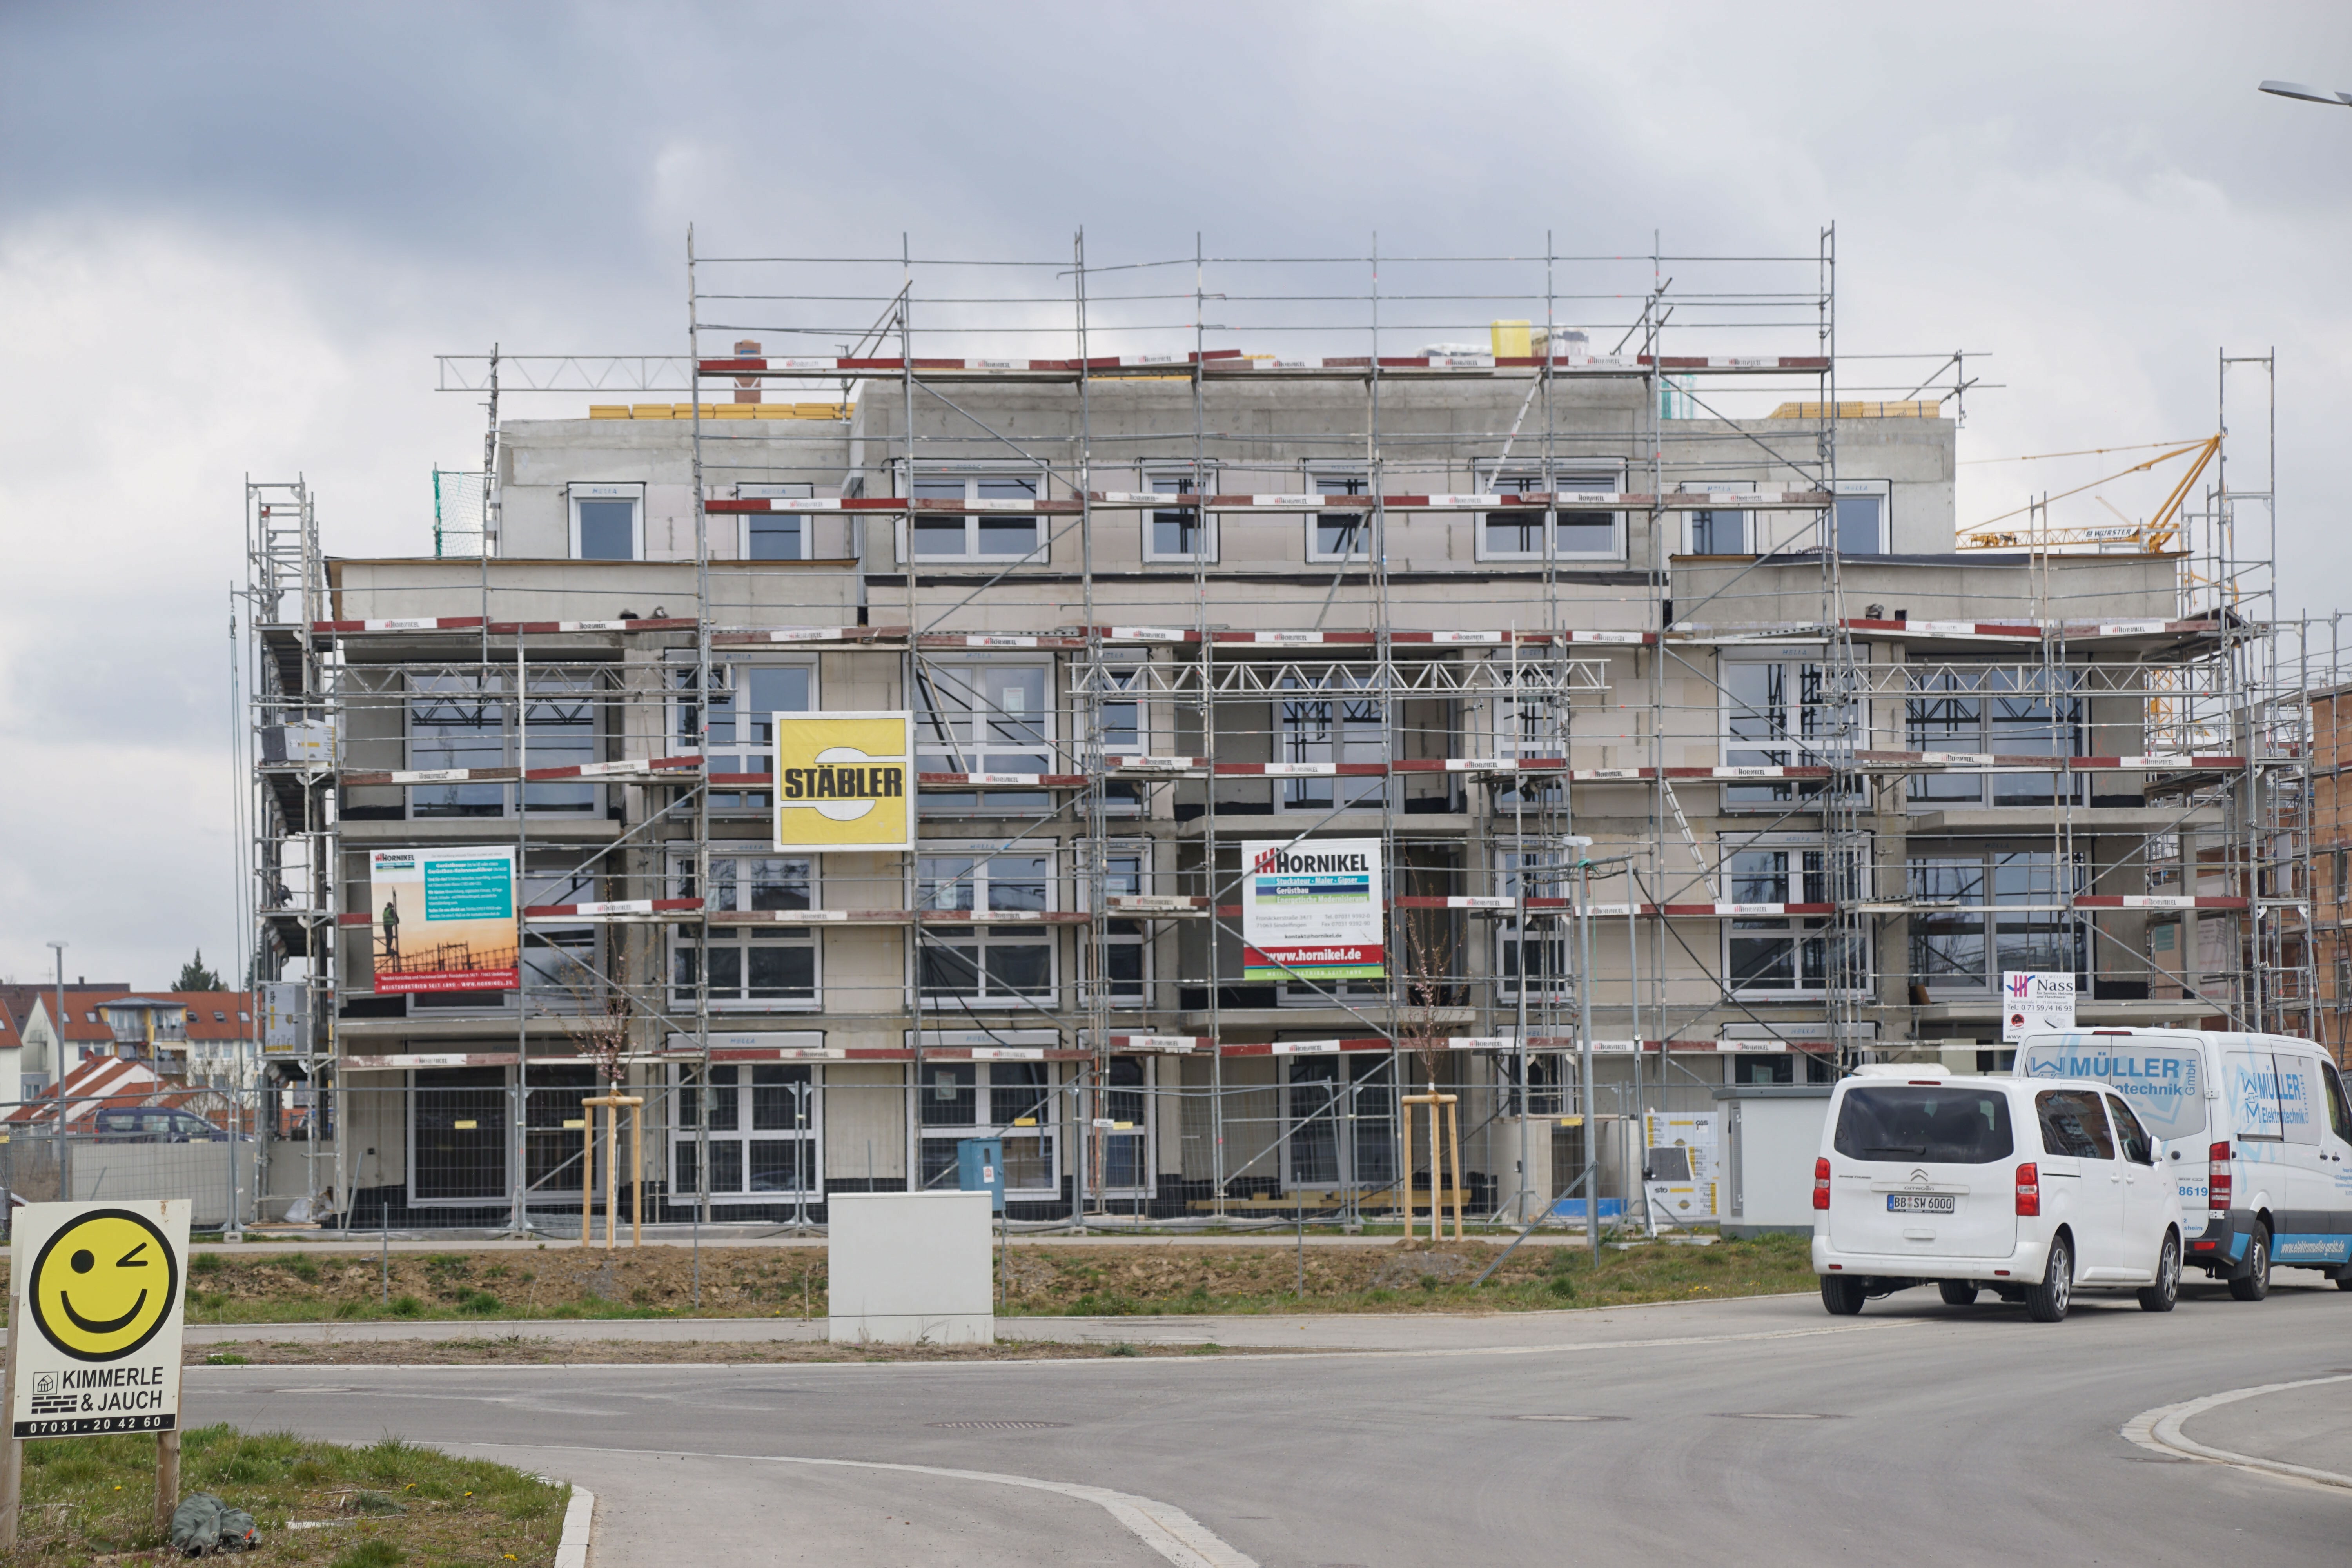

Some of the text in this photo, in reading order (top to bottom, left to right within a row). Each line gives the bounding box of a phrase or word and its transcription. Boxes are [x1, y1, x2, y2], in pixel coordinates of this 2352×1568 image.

[785, 765, 902, 798] STÄBLER
[383, 853, 414, 861] HORNIKEL
[1276, 848, 1369, 873] HORNIKEL
[1338, 877, 1357, 885] Gipser
[1267, 948, 1361, 961] www.hornikel.de
[2037, 979, 2073, 991] Nass
[2070, 1052, 2196, 1095] MÜLLER GmbH
[2257, 1065, 2301, 1100] MÜLLER
[2112, 1083, 2182, 1096] otechnik
[2179, 1187, 2208, 1196] 8619
[1895, 1198, 1906, 1207] BB
[1914, 1198, 1926, 1208] SW
[1928, 1198, 1952, 1209] 6000
[2281, 1240, 2345, 1256] www.elektromueller-gmbh.de
[63, 1367, 163, 1389] KIMMERLE
[81, 1390, 162, 1412] & JAUCH
[118, 1418, 135, 1428] 42
[144, 1417, 160, 1427] 60
